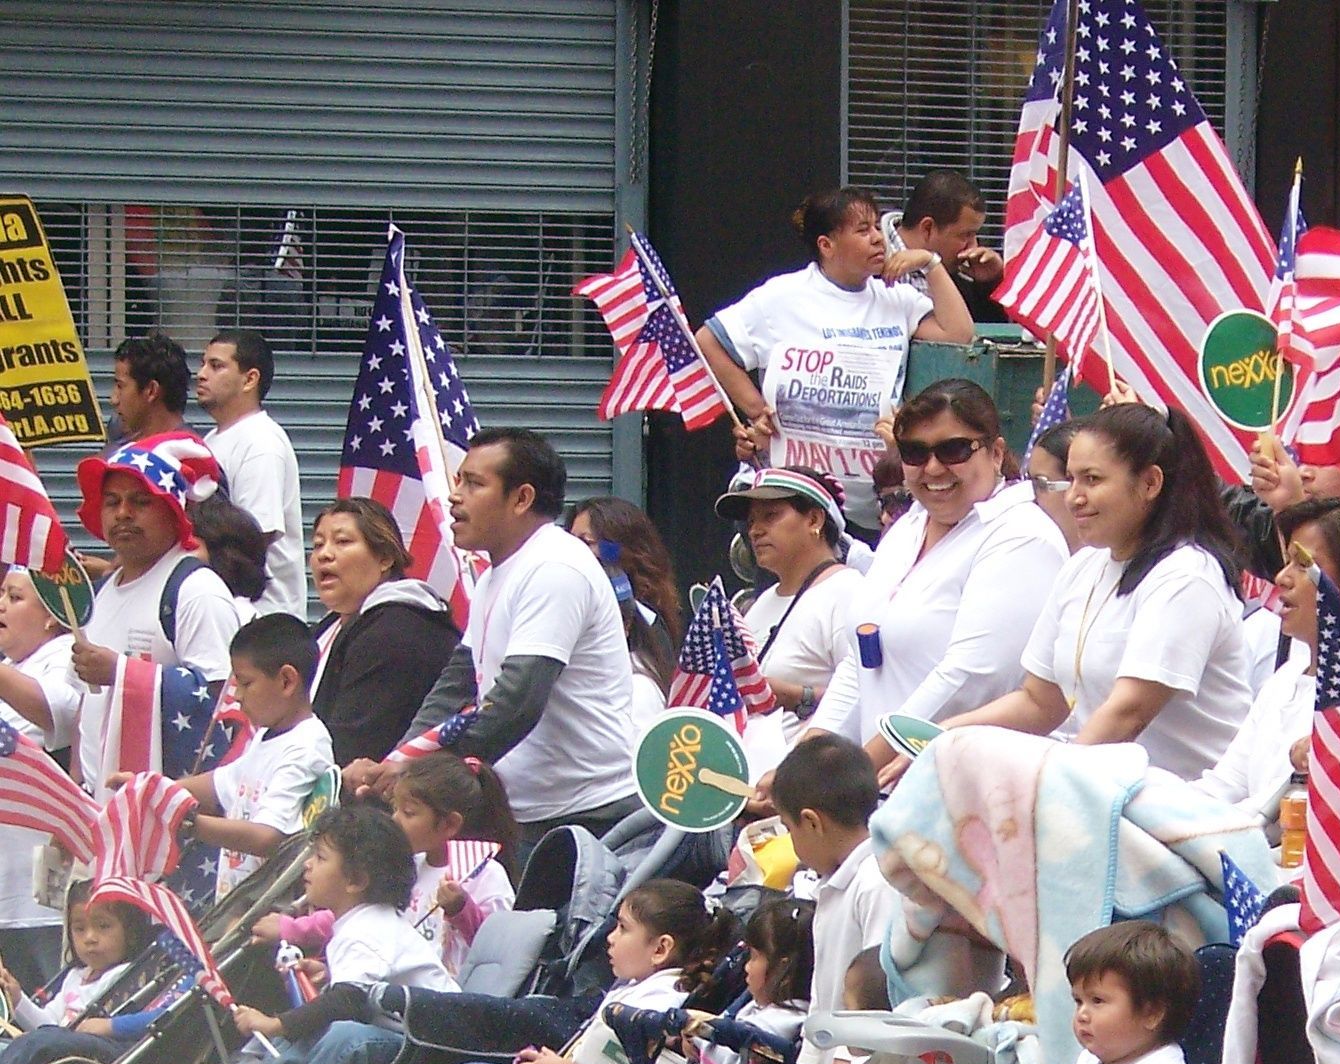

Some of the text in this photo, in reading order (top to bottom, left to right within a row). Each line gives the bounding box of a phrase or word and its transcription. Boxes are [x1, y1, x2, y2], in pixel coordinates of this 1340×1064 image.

[0, 256, 50, 288] hts
[781, 348, 834, 374] STOP
[788, 378, 882, 408] DEPORTATIONS!
[810, 374, 829, 389] the
[830, 366, 868, 390] RAIDS
[784, 438, 834, 474] MAY
[659, 724, 702, 816] nexxo
